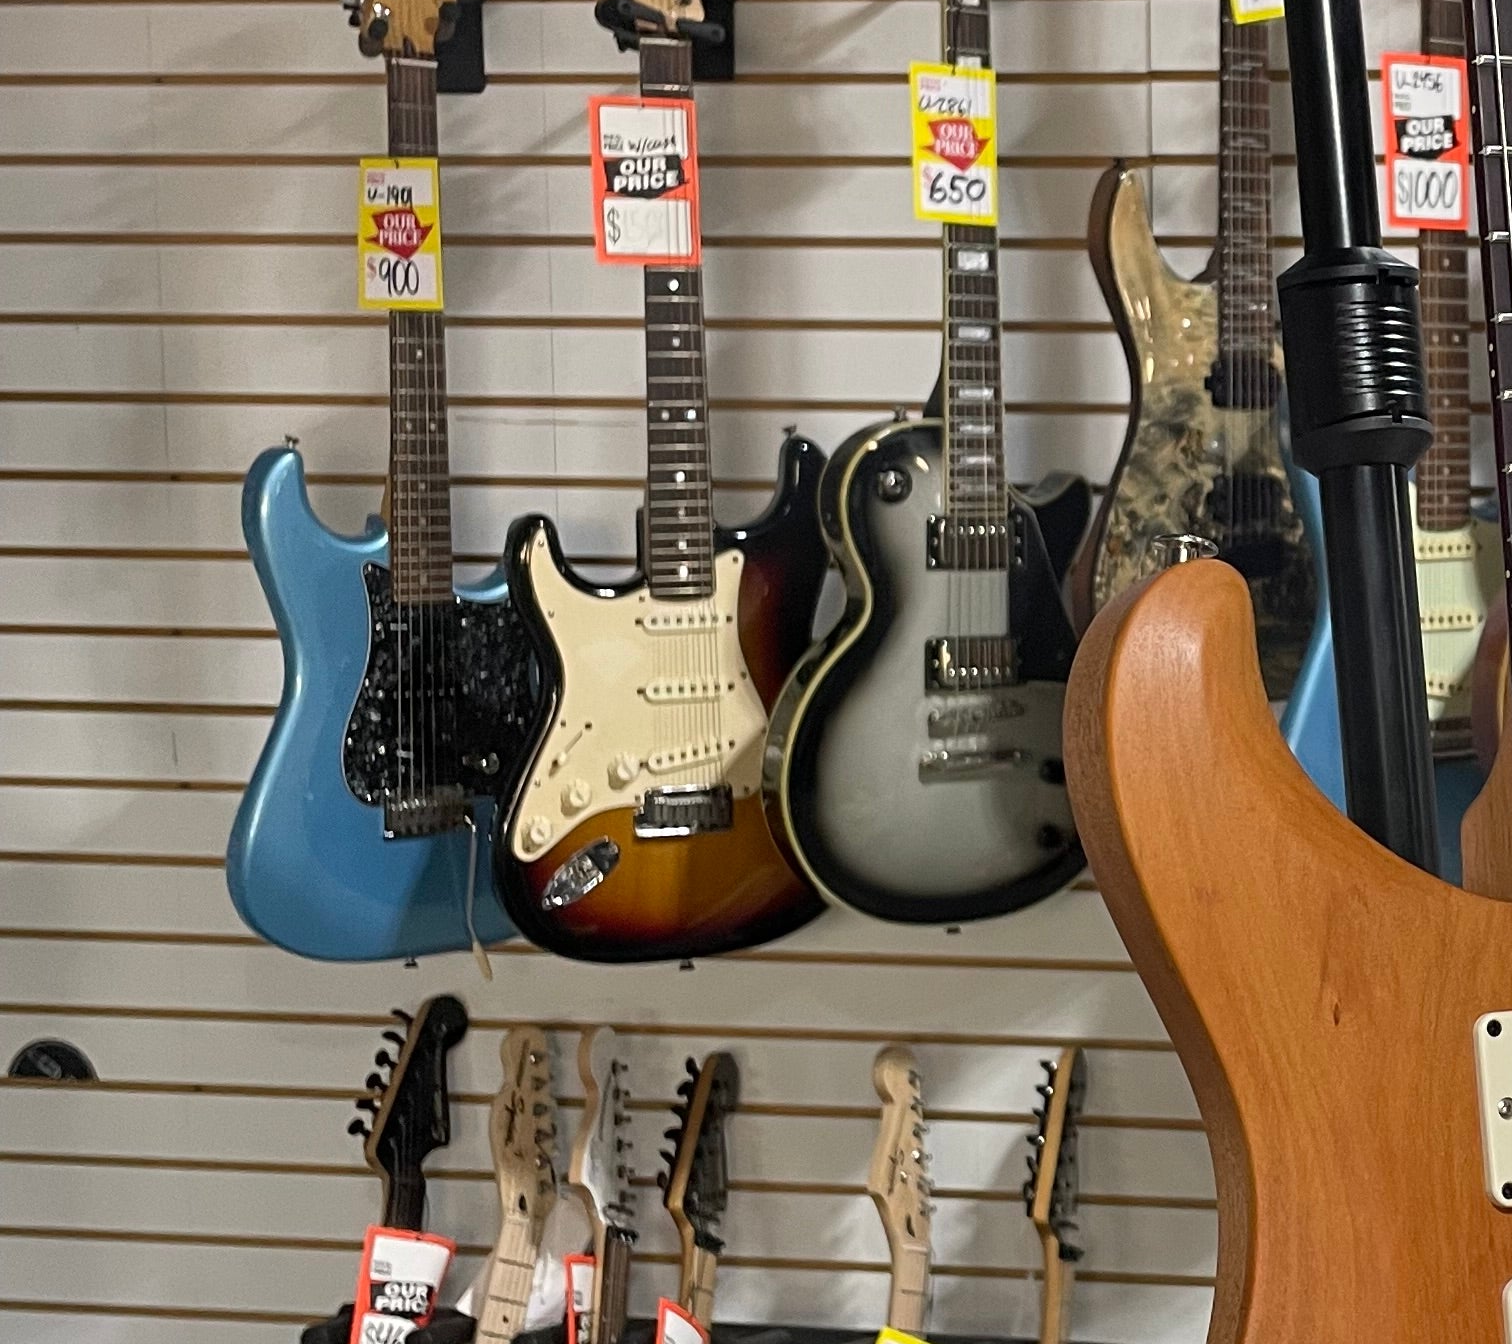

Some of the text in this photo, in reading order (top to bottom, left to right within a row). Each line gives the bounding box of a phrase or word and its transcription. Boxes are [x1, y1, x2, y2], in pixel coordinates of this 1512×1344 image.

[1405, 117, 1445, 137] OUR
[1401, 131, 1453, 153] PRICE
[619, 157, 667, 177] OUR
[613, 170, 679, 193] PRICE
[383, 213, 417, 230] OUR
